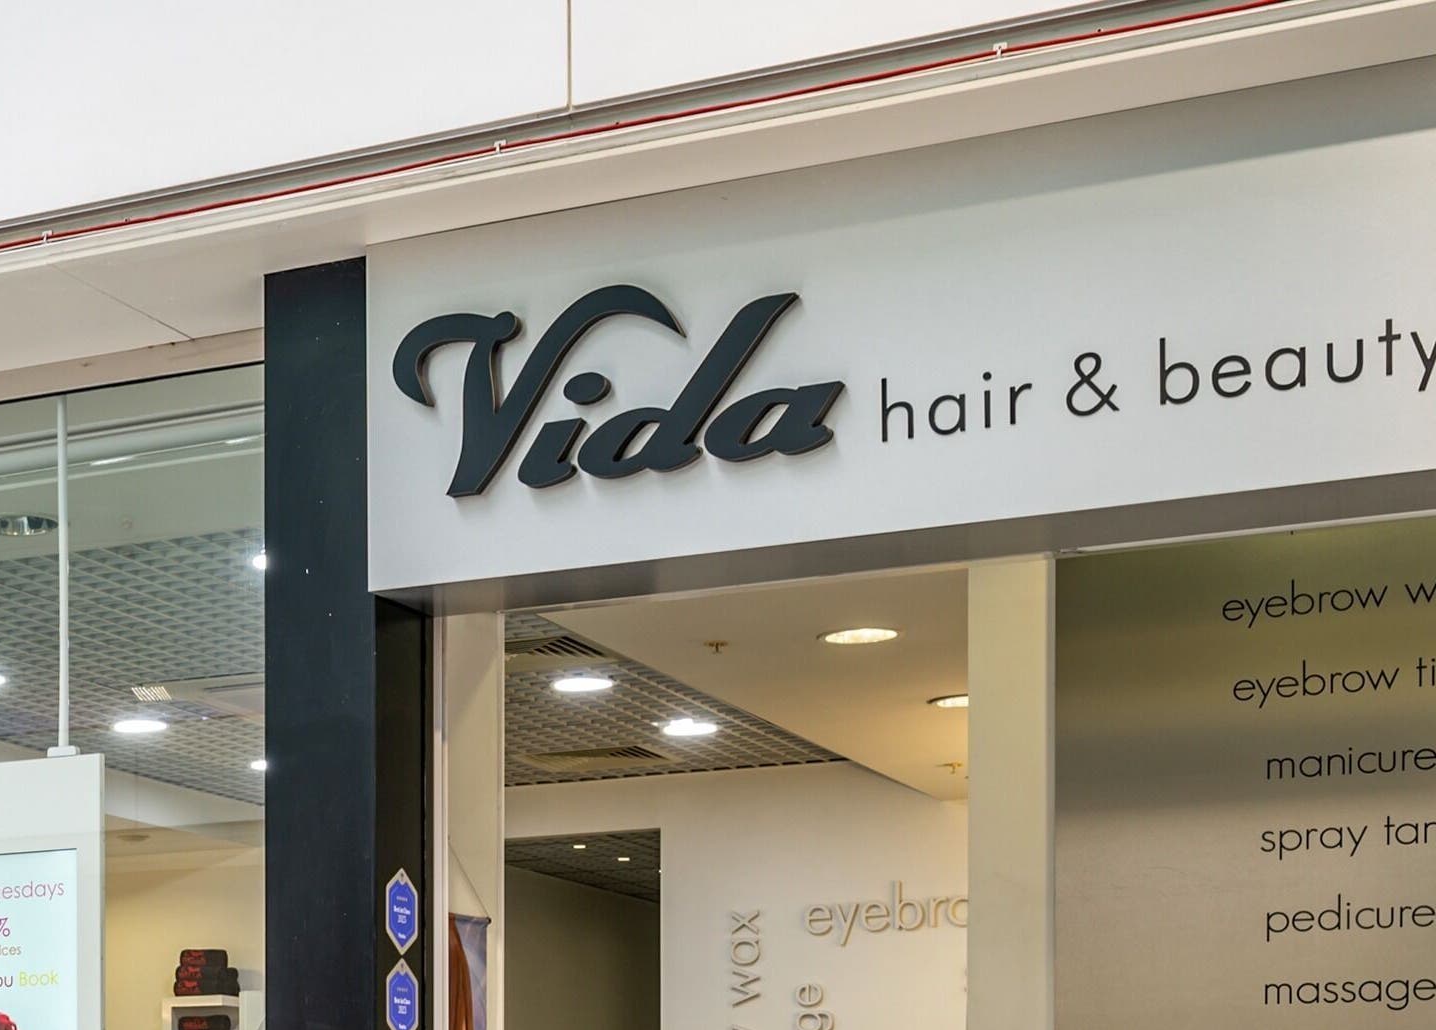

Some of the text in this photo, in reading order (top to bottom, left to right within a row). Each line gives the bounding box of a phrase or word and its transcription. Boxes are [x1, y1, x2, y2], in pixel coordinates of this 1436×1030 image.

[393, 284, 845, 498] Vida
[881, 318, 1436, 443] hair & beauty
[1222, 579, 1388, 629] eyebrow
[1233, 659, 1400, 709] eyebrow
[1266, 746, 1436, 781] manicure
[1260, 824, 1368, 861] spray
[1266, 893, 1436, 942] pedicure
[18, 970, 60, 987] Book
[730, 909, 763, 1009] wax
[1264, 978, 1436, 1011] massage
